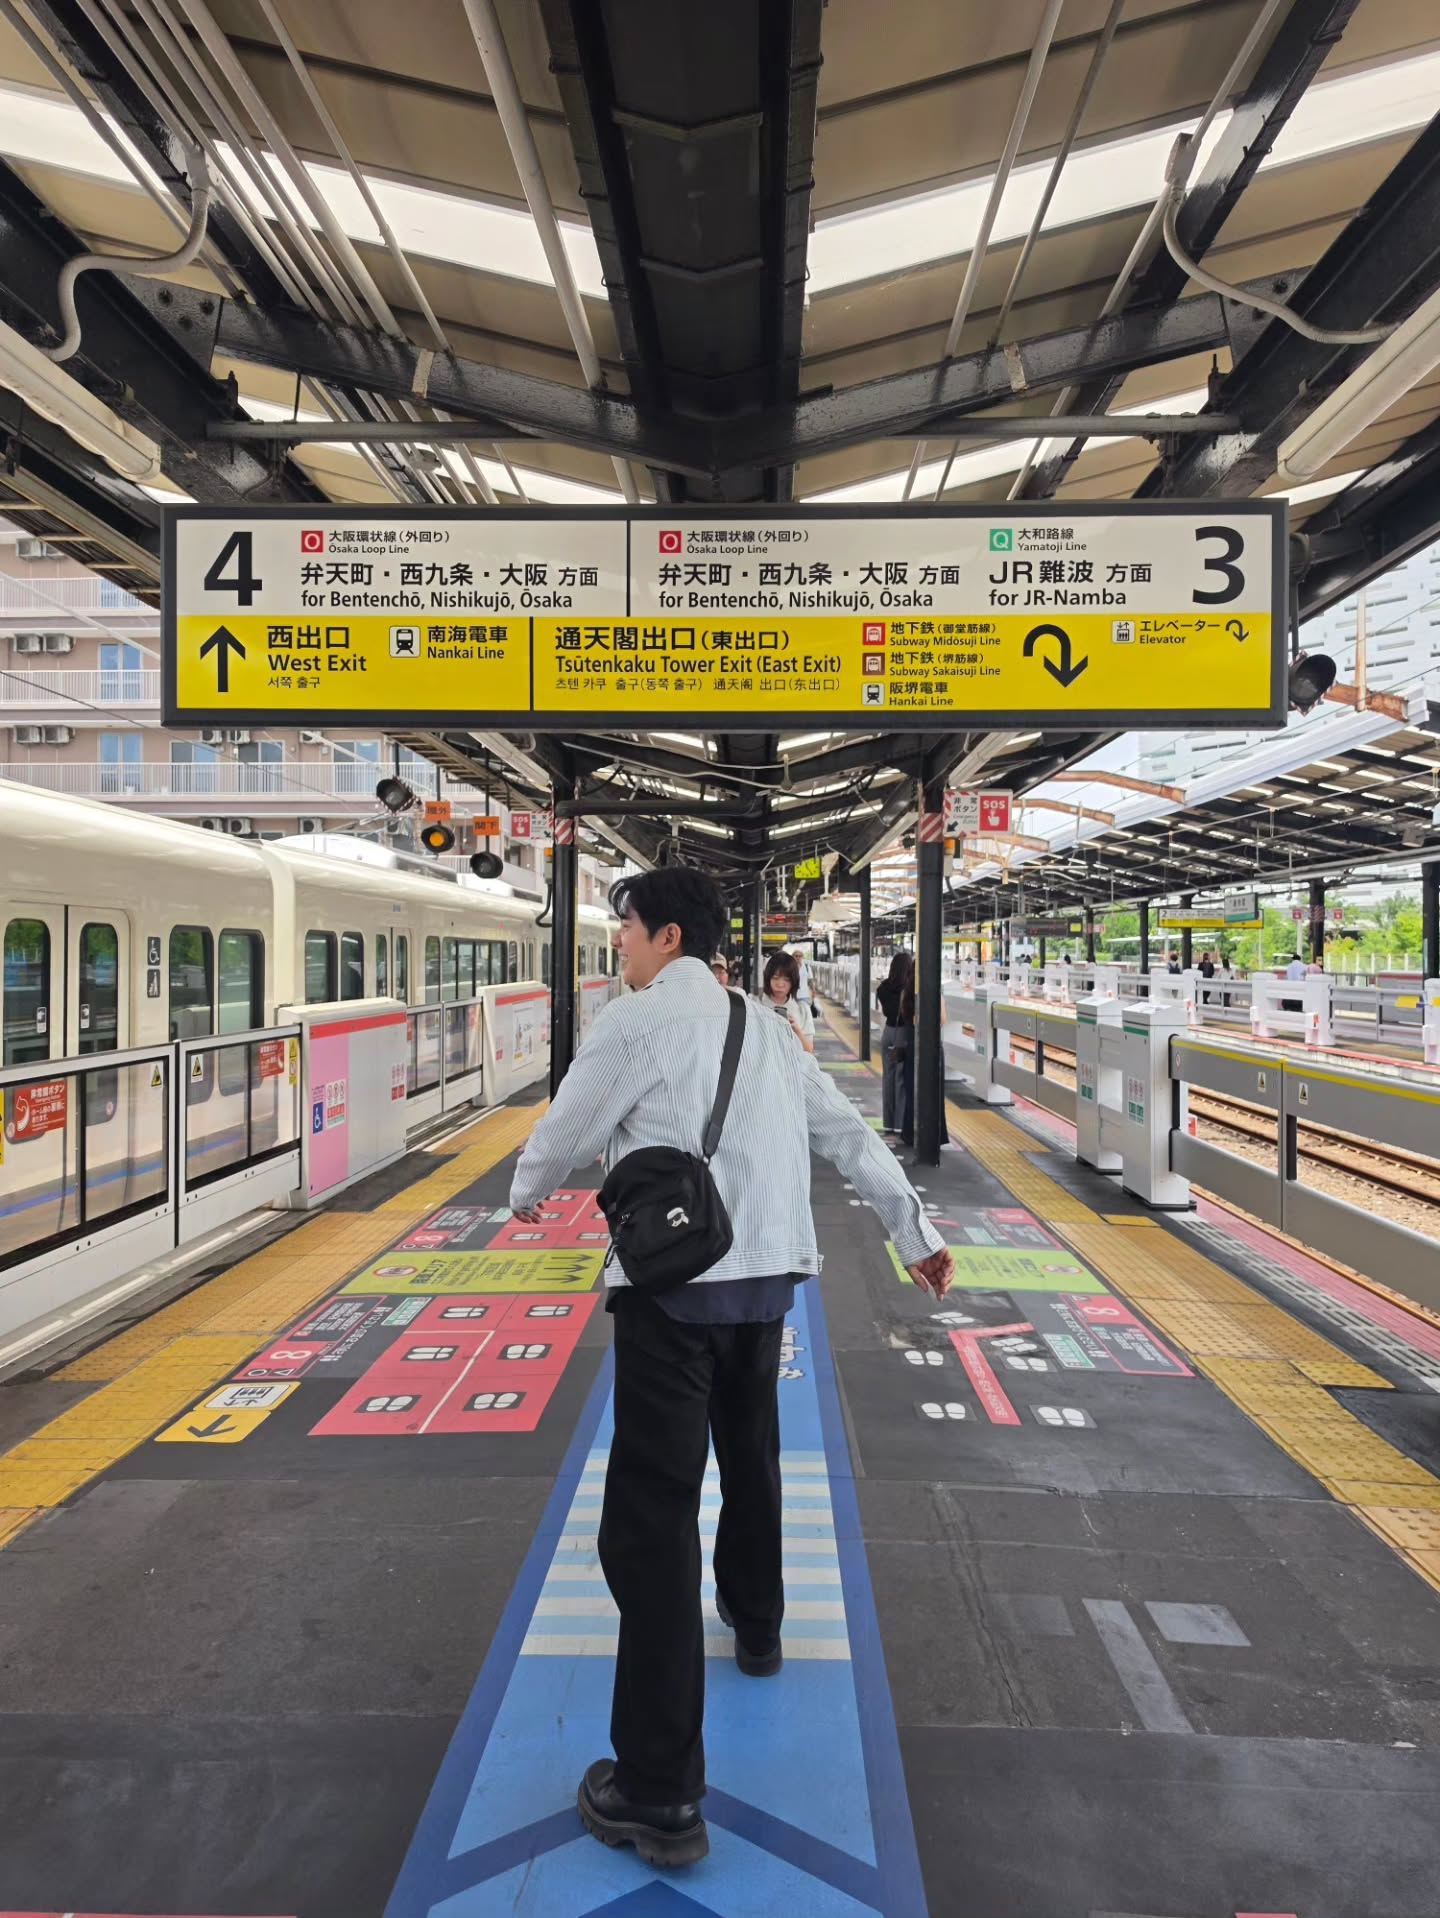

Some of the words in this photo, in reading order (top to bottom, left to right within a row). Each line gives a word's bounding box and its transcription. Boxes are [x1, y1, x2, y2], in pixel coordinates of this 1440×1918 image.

[329, 530, 449, 544] 大阪環状線（外回り）
[687, 531, 808, 542] 大阪環状線（外回り）
[991, 530, 1011, 550] Q
[1019, 528, 1073, 540] 大和路線
[303, 532, 321, 551] O
[660, 532, 681, 552] O
[1018, 542, 1062, 553] Yamatoji
[1066, 542, 1086, 550] Line
[362, 545, 385, 555] Loop
[389, 545, 409, 553] Line
[720, 545, 744, 555] Loop
[748, 545, 767, 553] Line
[204, 532, 262, 606] 4
[1193, 526, 1245, 604] 3
[301, 562, 547, 586] 弁天町・西九条・大阪
[559, 567, 598, 586] 方面
[659, 562, 908, 586] 弁天町・西九条・大阪
[919, 565, 960, 585] 方面
[1106, 563, 1152, 583] 方面
[301, 590, 325, 606] for
[331, 590, 424, 609] Bentenchō,
[431, 591, 514, 612] Nishikujō,
[520, 589, 572, 608] Ōsaka
[659, 591, 683, 608] for
[689, 591, 783, 610] Bentenchō,
[789, 591, 874, 611] Nishikujō,
[880, 588, 932, 607] Ōsaka
[989, 589, 1018, 606] for
[1024, 588, 1126, 605] JR-Namba
[891, 622, 995, 634] 地下鉄（御堂筋線）
[1140, 619, 1220, 632] エレベーター
[267, 625, 349, 649] 西出口
[427, 626, 507, 643] 南海電車
[555, 626, 789, 650] 通天閣出口（東出口）
[1140, 634, 1186, 644] Elevator
[890, 637, 930, 647] Subway
[934, 636, 976, 647] Midōsuji
[980, 636, 1000, 645] Line
[428, 646, 473, 658] Nankai
[478, 647, 504, 659] Line
[890, 652, 983, 664] 地下鉄（堺筋線）
[268, 655, 321, 671] West
[328, 654, 367, 671] Exit
[556, 655, 655, 672] Tsūtenkaku
[660, 656, 715, 672] Tower
[721, 655, 752, 672] Exit
[757, 656, 798, 672] (East
[804, 655, 840, 672] Exit)
[890, 666, 929, 678] Subway
[933, 666, 976, 677] Sakaisuji
[980, 666, 1000, 675] Line
[268, 677, 292, 688] 서쪽
[297, 676, 320, 688] 출구
[584, 678, 606, 690] 카쿠
[890, 682, 948, 694] 阪堺電車
[889, 696, 927, 705] Hankai
[931, 696, 953, 705] Line
[982, 800, 1006, 809] SOS
[513, 815, 529, 823] SOS
[270, 1350, 312, 1359] 8
